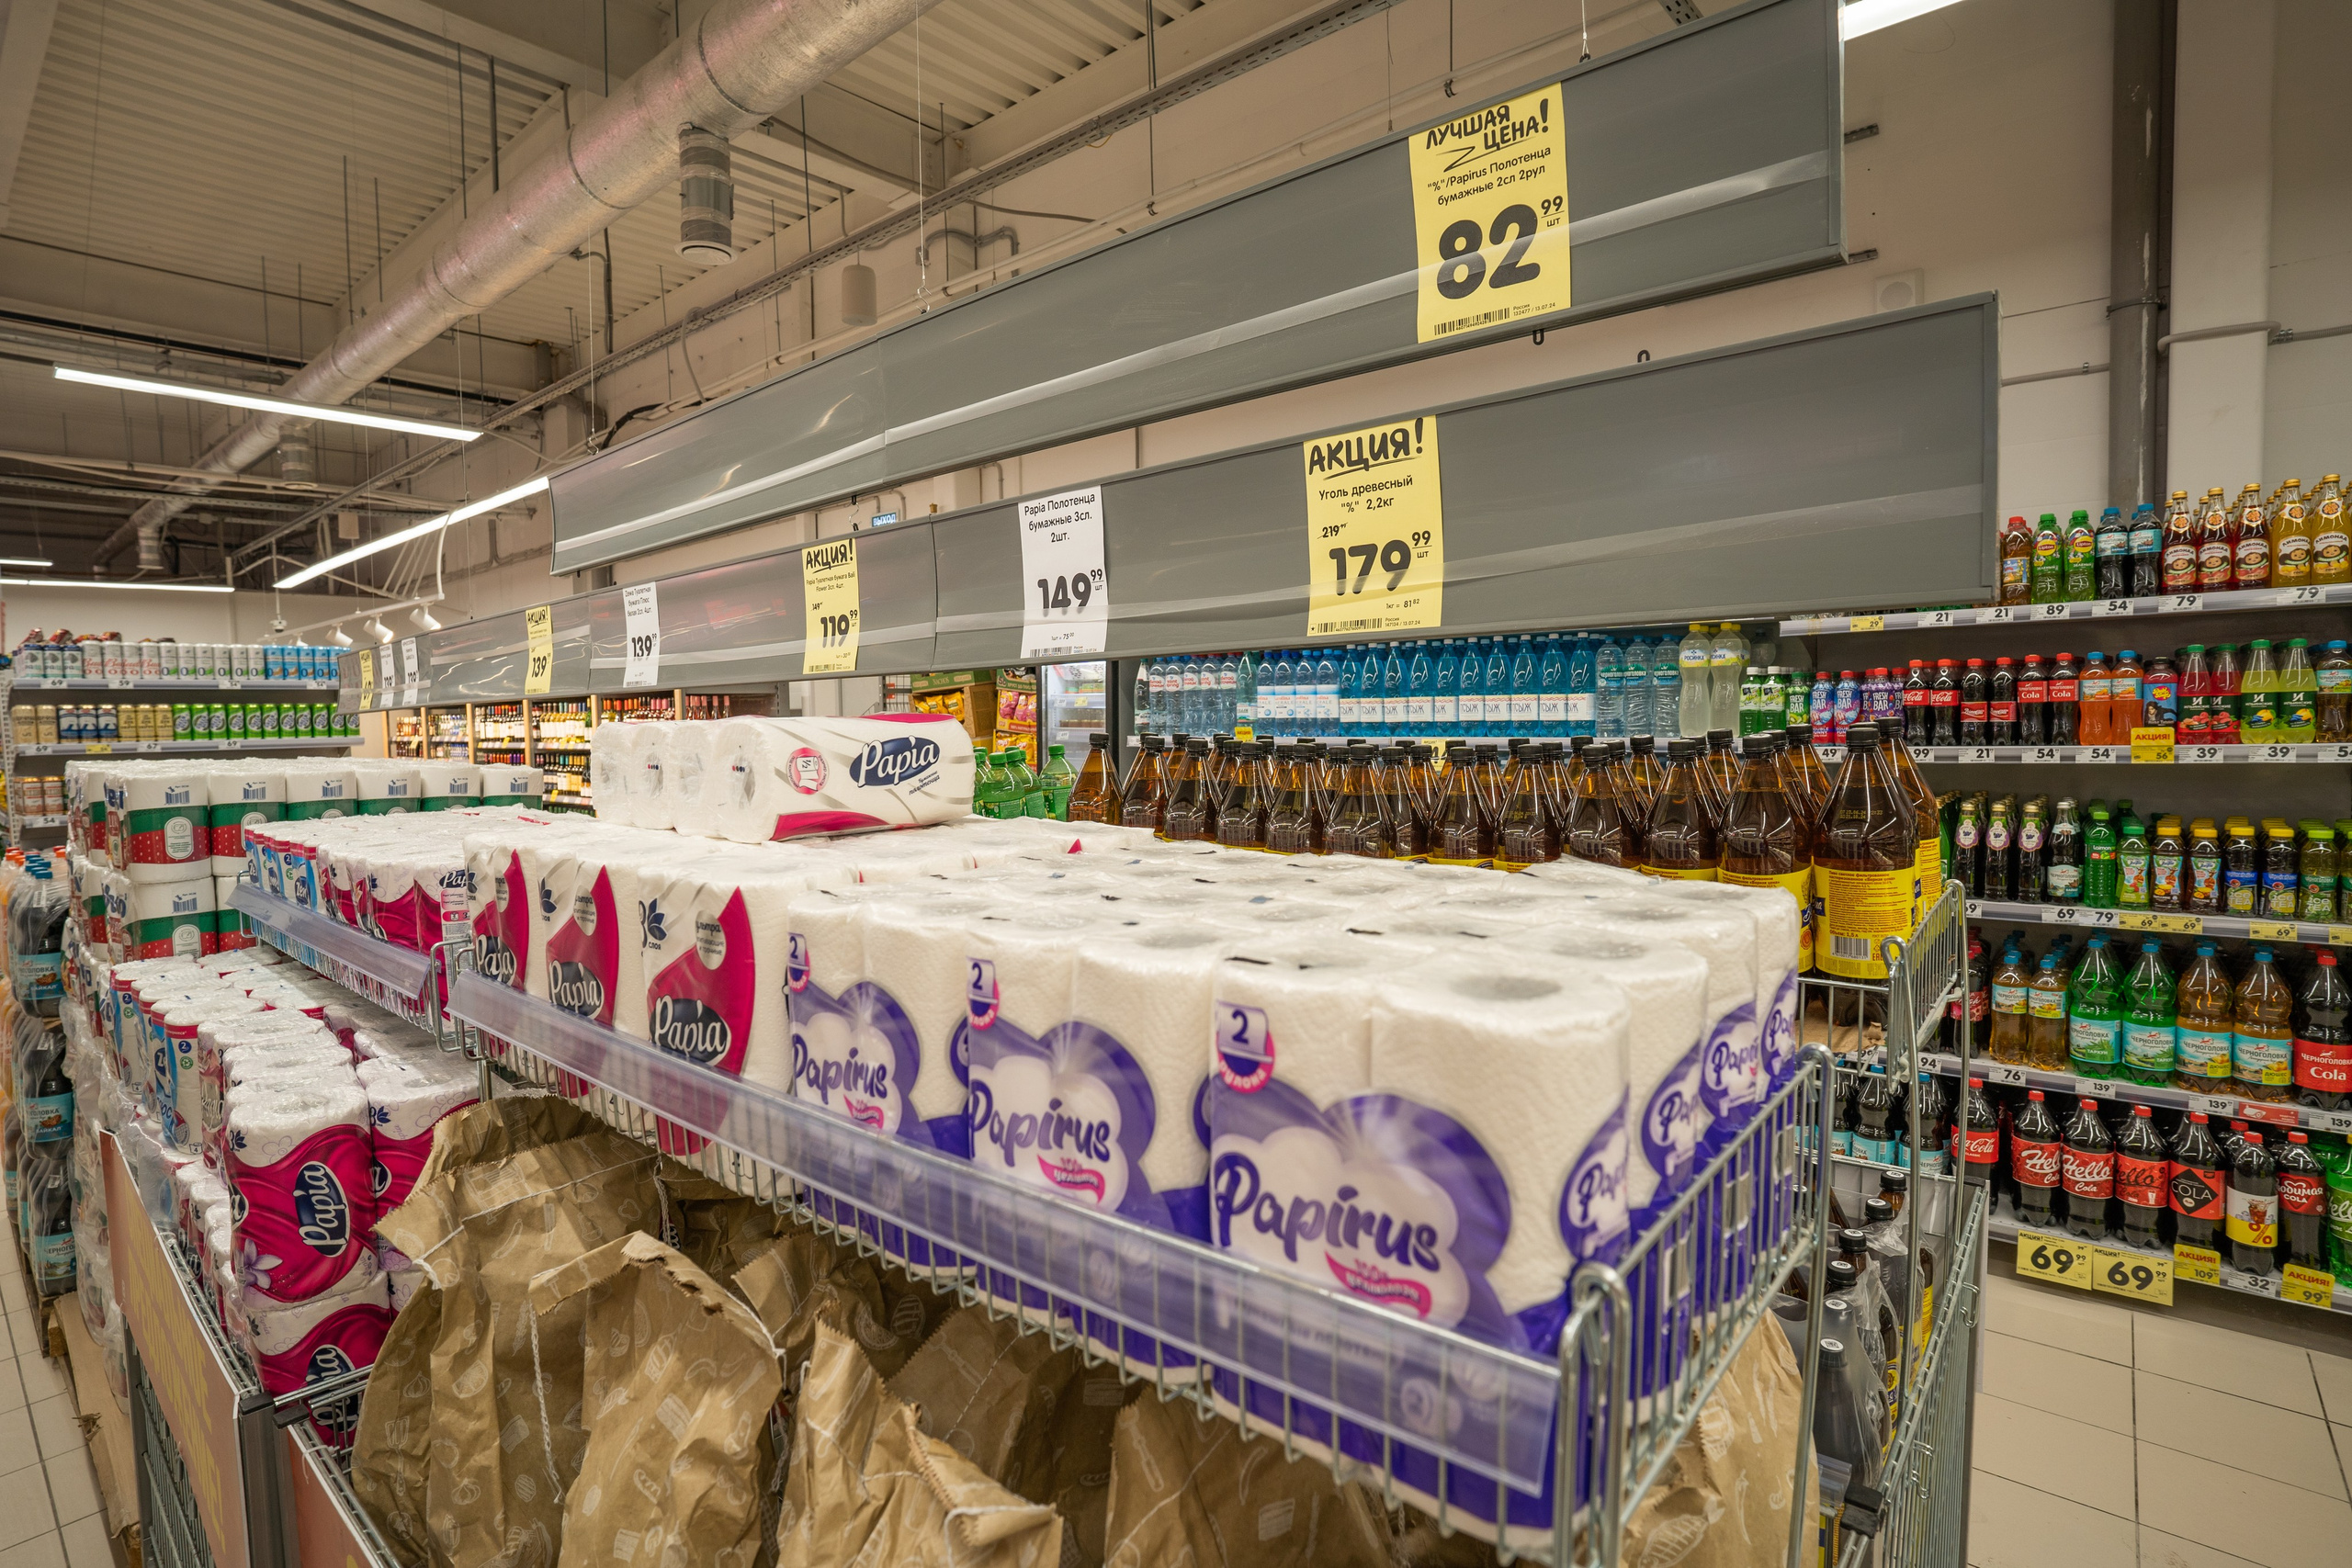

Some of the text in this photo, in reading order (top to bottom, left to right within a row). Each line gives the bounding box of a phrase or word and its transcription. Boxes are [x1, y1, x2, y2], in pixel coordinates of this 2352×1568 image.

[1425, 104, 1510, 150] ЛУЧШАЯ
[1483, 98, 1549, 151] ЦЕНА!
[1427, 146, 1551, 192] "%"/Papirus Полотенца
[1437, 164, 1545, 205] бумажные 2сл 2рул
[1541, 196, 1564, 216] 99
[1546, 217, 1561, 228] шт
[1436, 204, 1541, 299] 82
[1534, 302, 1556, 311] 13.07.24
[1308, 417, 1424, 475] АКЦИЯ!
[1318, 475, 1413, 501] Уголь древесный
[1024, 493, 1095, 516] Papia Полотенца
[1366, 497, 1395, 511] 2,2кг
[873, 513, 897, 525] ВЫХОД
[1028, 511, 1092, 532] бумажные 3сл.
[1050, 531, 1070, 543] 2шт.
[1321, 525, 1340, 538] 219
[2315, 535, 2347, 544] ЛИМОНАД
[806, 538, 854, 570] АКЦИЯ!
[1417, 550, 1429, 558] шт
[1329, 530, 1431, 596] 179 99
[1037, 568, 1102, 617] 149 99
[2297, 587, 2319, 599] 79
[1403, 600, 1412, 608] 81
[2109, 601, 2128, 611] 54
[2176, 595, 2197, 606] 79
[1994, 608, 2009, 618] 21
[2046, 604, 2064, 615] 89
[526, 609, 548, 626] АКЦИЯ!
[1935, 613, 1950, 622] 21
[820, 609, 858, 649] 119 99
[631, 635, 652, 661] 139
[531, 655, 548, 678] 139
[1789, 694, 1804, 703] FRESH
[1812, 690, 1826, 699] FRESH
[1837, 690, 1852, 698] FRESH
[1872, 692, 1889, 701] FRESH
[2021, 691, 2040, 700] Cola
[2052, 690, 2071, 699] Cola
[1790, 703, 1804, 713] BAR
[1812, 698, 1826, 709] BAR
[1837, 698, 1852, 709] BAR
[1872, 700, 1889, 711] BAR
[1822, 749, 1838, 758] 49
[1913, 749, 1930, 758] 99
[1976, 749, 1991, 759] 21
[2036, 749, 2055, 759] 54
[2091, 749, 2110, 759] 54
[2197, 747, 2218, 758] 39
[2267, 746, 2290, 758] 39
[857, 735, 939, 788] Papia
[2228, 897, 2255, 906] TEA
[2271, 900, 2295, 908] TEA
[2057, 908, 2075, 919] 69
[2306, 904, 2332, 912] TEA
[2095, 911, 2113, 922] 79
[2183, 921, 2197, 930] 69
[2277, 928, 2290, 937] 69
[789, 936, 798, 960] 2
[971, 962, 983, 991] 2
[551, 960, 602, 1011] Papia
[654, 994, 728, 1055] Papia
[1230, 1009, 1250, 1045] 2
[2183, 1041, 2230, 1052] ЧЕРНОГОЛОВКА
[2237, 1047, 2288, 1059] ЧЕРНОГОЛОВКА
[1920, 1058, 1937, 1068] 94
[792, 1033, 888, 1105] Papirus
[2310, 1066, 2346, 1081] Cola
[2004, 1070, 2021, 1080] 76
[2093, 1082, 2110, 1091] 139
[2208, 1100, 2227, 1109] 139
[968, 1078, 1112, 1168] Papirus
[2331, 1118, 2352, 1128] 139
[2063, 1155, 2111, 1179] Hello
[2075, 1182, 2098, 1192] Cola
[2171, 1180, 2213, 1201] COLA
[2284, 1194, 2308, 1203] COLA
[293, 1164, 347, 1247] Papia
[1214, 1151, 1441, 1273] Papirus
[2018, 1232, 2043, 1241] АКЦИЯ!
[2094, 1248, 2120, 1258] АКЦИЯ!
[2178, 1251, 2216, 1264] АКЦИЯ!
[2030, 1245, 2075, 1274] 69
[2107, 1261, 2154, 1291] 69
[2194, 1269, 2213, 1280] 109
[2288, 1271, 2330, 1287] АКЦИЯ!
[2248, 1276, 2271, 1291] 32
[2302, 1290, 2324, 1303] 99
